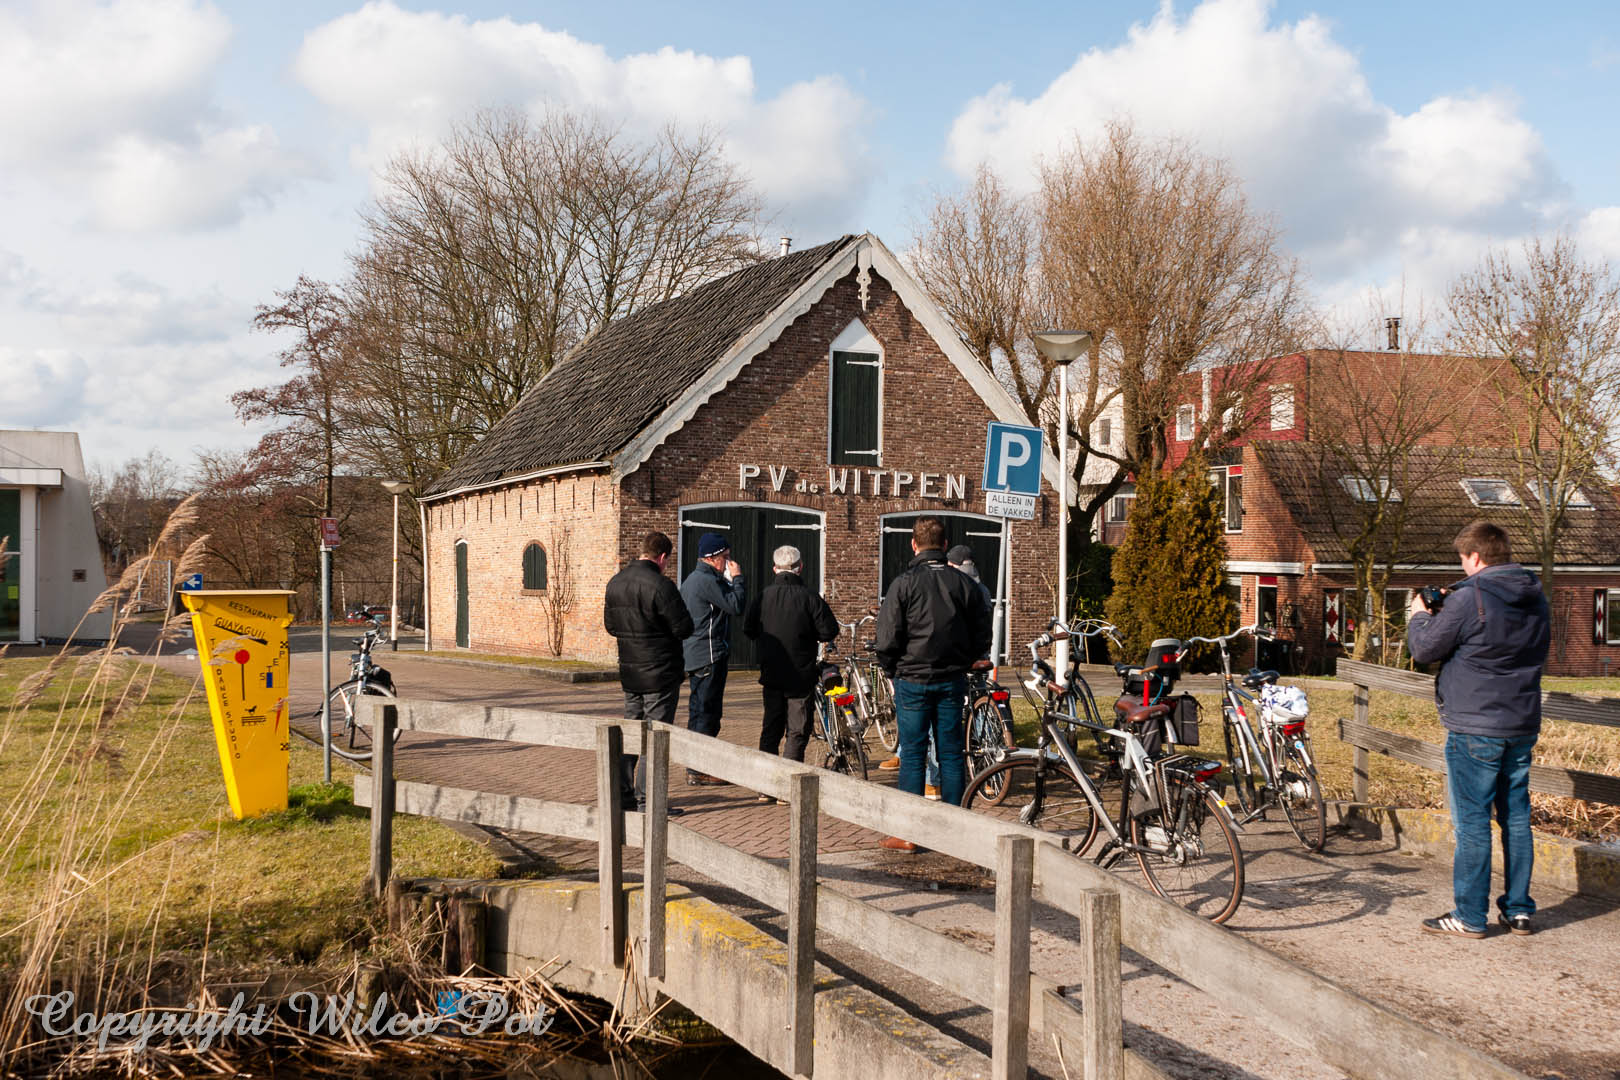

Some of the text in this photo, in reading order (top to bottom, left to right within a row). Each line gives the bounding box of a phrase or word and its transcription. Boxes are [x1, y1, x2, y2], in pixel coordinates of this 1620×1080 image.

[997, 431, 1031, 486] P
[795, 479, 818, 493] de
[828, 467, 966, 499] WITPEN
[988, 505, 1034, 518] DE VAKKEN
[992, 495, 1033, 506] ALLEEN IN
[229, 601, 278, 621] RESTAURANT
[216, 668, 241, 759] DANCE STUDIO
